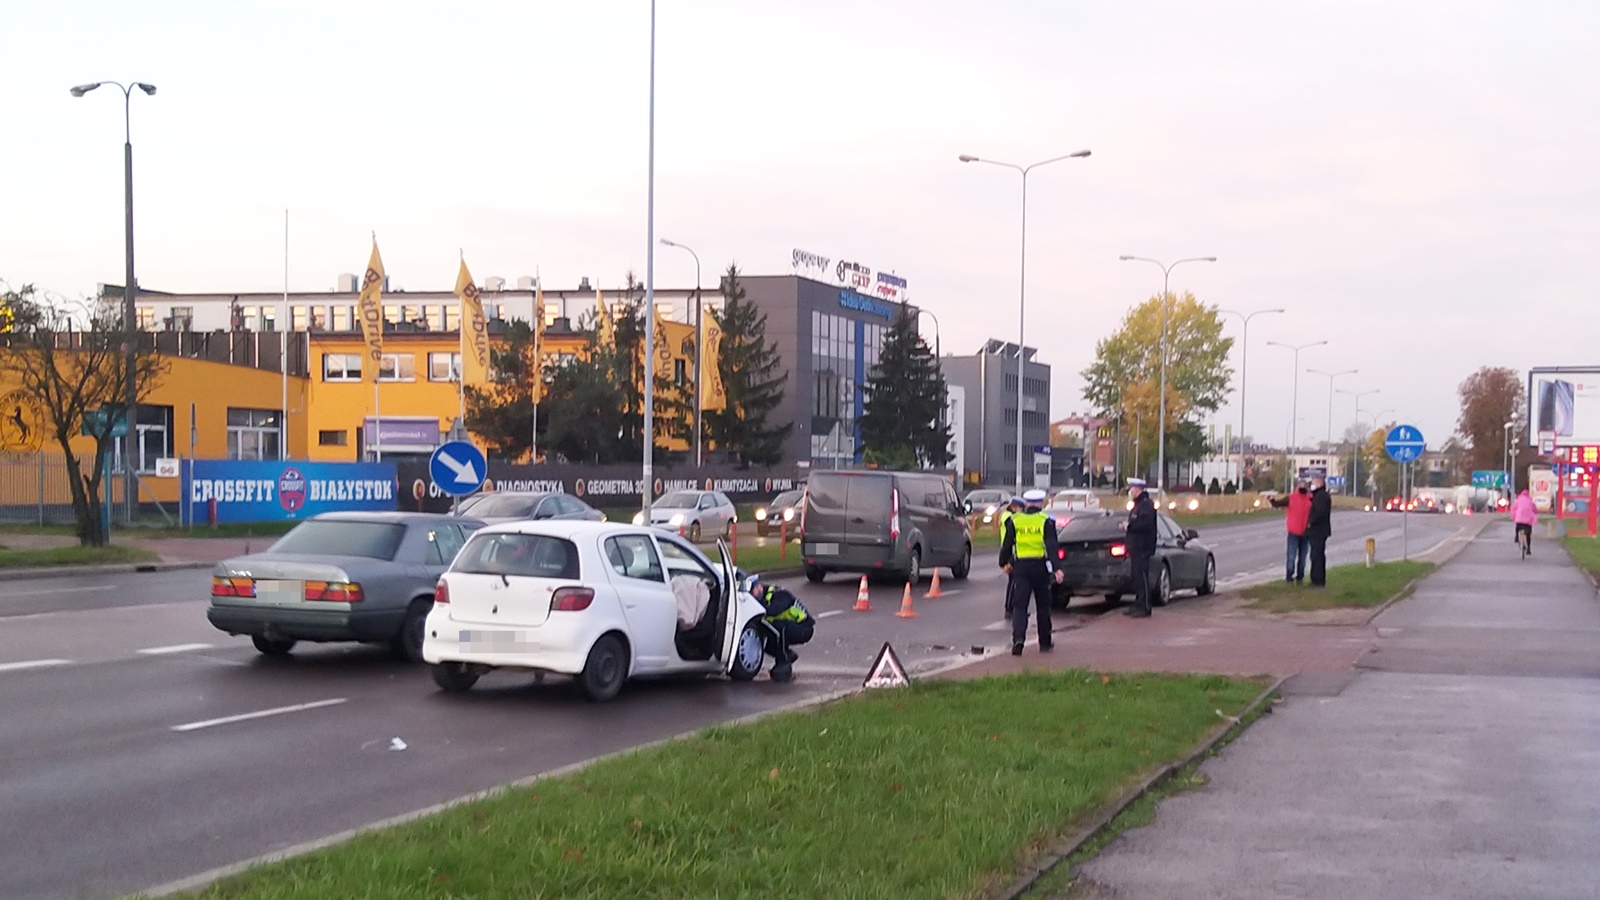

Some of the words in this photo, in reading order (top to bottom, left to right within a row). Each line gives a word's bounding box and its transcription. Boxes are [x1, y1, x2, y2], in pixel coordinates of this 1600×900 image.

[192, 479, 275, 502] CROSSFIT
[310, 479, 392, 501] BIAŁYSTOK
[496, 480, 564, 494] DIAGNOSTYKA
[587, 480, 634, 495] GEOMETRIA
[713, 479, 759, 492] KLIMATYZACJA
